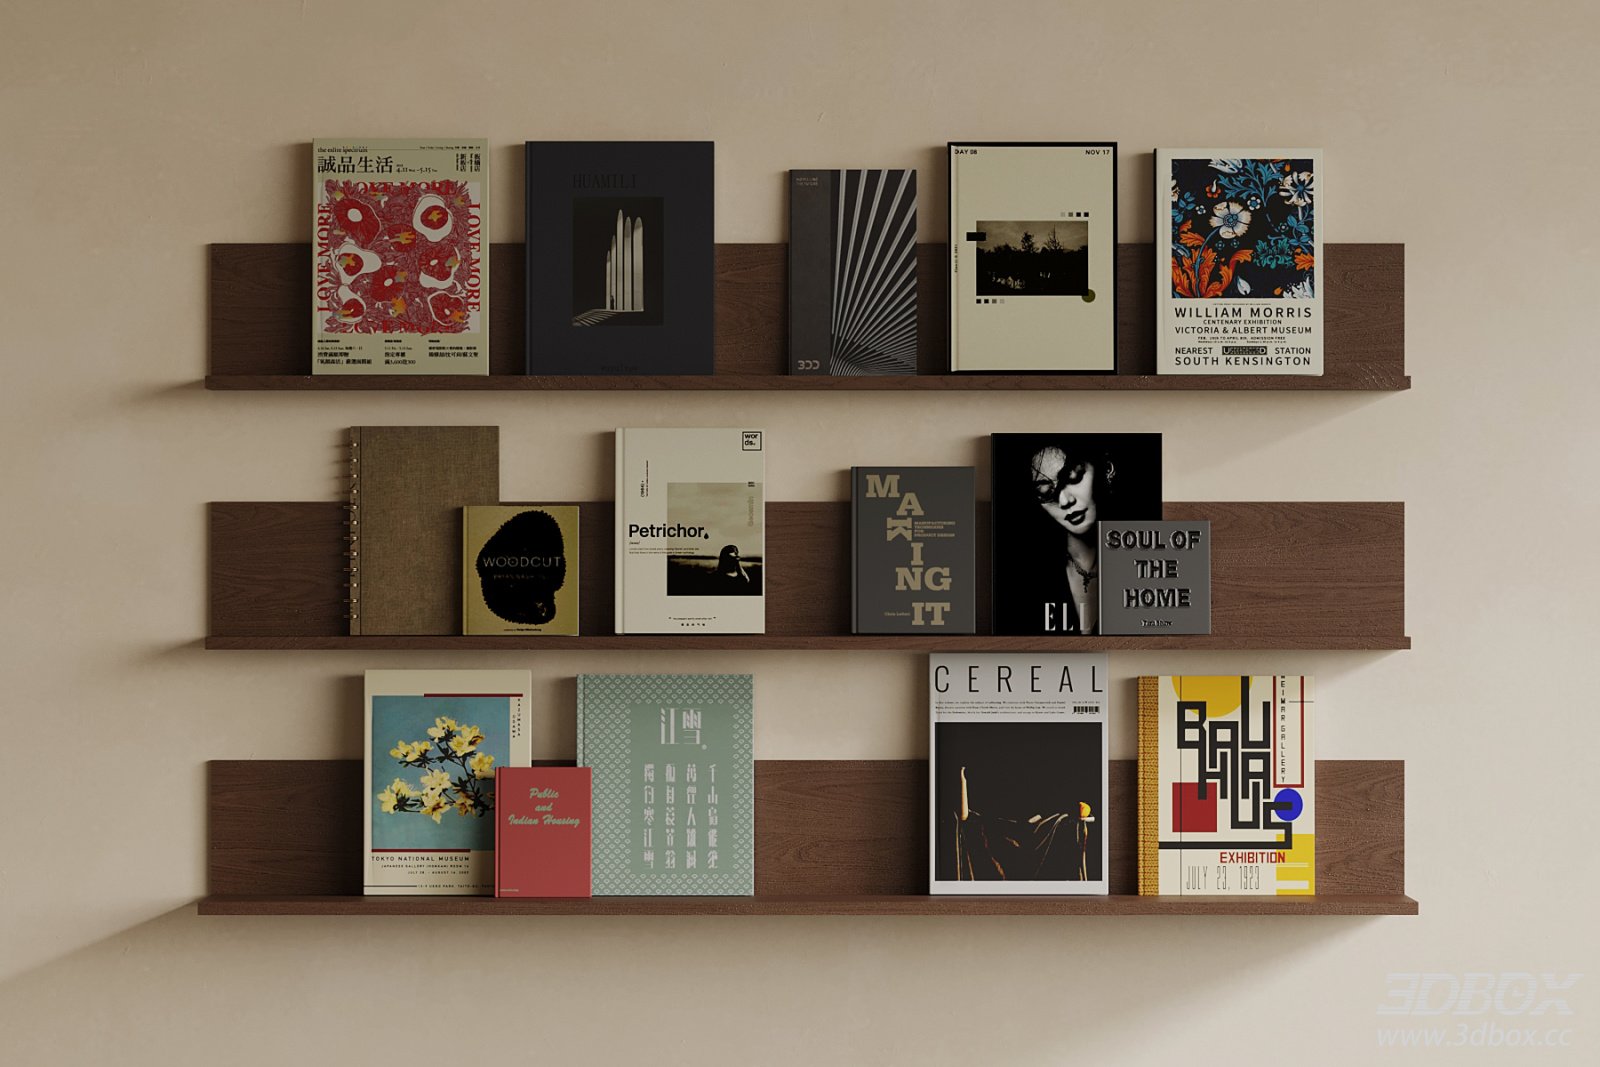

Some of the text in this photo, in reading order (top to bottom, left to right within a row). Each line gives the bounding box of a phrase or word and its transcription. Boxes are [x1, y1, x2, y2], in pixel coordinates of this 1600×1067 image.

[317, 156, 393, 173] 誠品生活
[1175, 307, 1312, 318] WILLIAM MORRIS
[1175, 326, 1312, 334] VICTORIA & ALBERT MUSEUM
[1175, 347, 1213, 355] NEAREST
[1274, 347, 1311, 355] STATION
[1175, 356, 1310, 366] SOUTH KENSINGTON
[1105, 530, 1201, 549] SOUL OF
[482, 556, 561, 568] WOODCUT
[1134, 560, 1179, 578] THE
[1123, 588, 1191, 608] HOME
[912, 602, 950, 626] IT
[935, 665, 1103, 693] CEREAL
[529, 787, 559, 799] Public
[535, 803, 553, 811] and
[508, 814, 580, 828] Indian Housing
[1220, 851, 1286, 864] EXHIBITION
[1186, 865, 1208, 890] JULY
[1239, 865, 1260, 890] 1923
